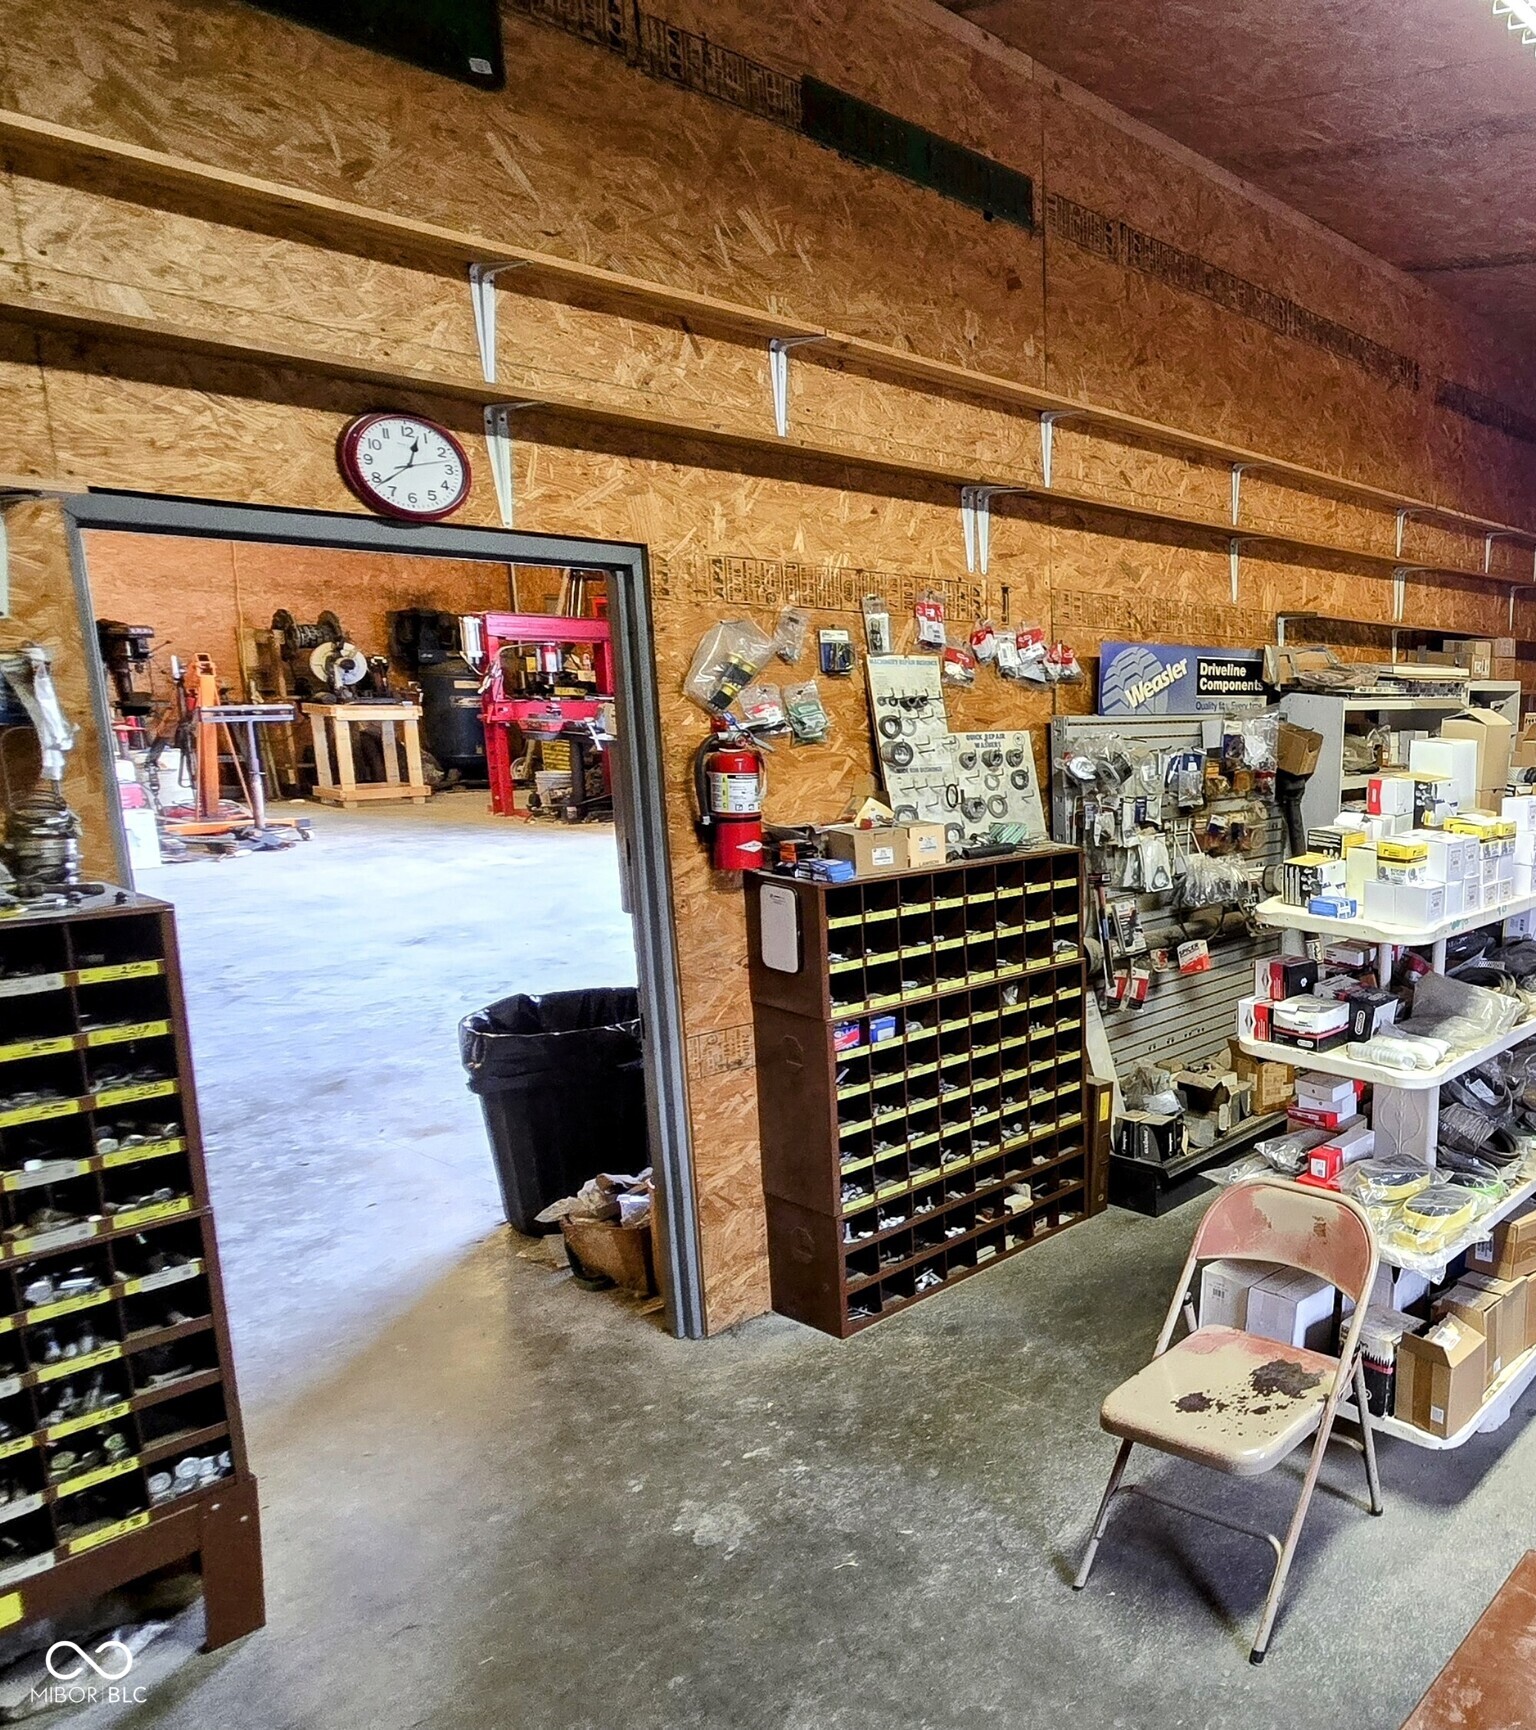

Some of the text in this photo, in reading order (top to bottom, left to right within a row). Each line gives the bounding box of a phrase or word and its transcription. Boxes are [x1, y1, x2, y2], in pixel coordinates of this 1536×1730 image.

[382, 427, 390, 439] 11
[401, 426, 415, 438] 12
[368, 438, 382, 451] 10
[423, 433, 428, 444] 1
[437, 447, 447, 458] 2
[363, 453, 373, 465] 9
[444, 464, 454, 475] 3
[371, 471, 381, 483] 8
[388, 485, 397, 497] 7
[440, 480, 450, 490] 4
[408, 492, 417, 504] 6
[427, 490, 437, 501] 5
[1200, 663, 1247, 677] Driveline
[1124, 658, 1188, 708] Weasler
[1200, 677, 1263, 693] Components
[1196, 701, 1217, 712] Quality
[1179, 943, 1199, 957] SPICER
